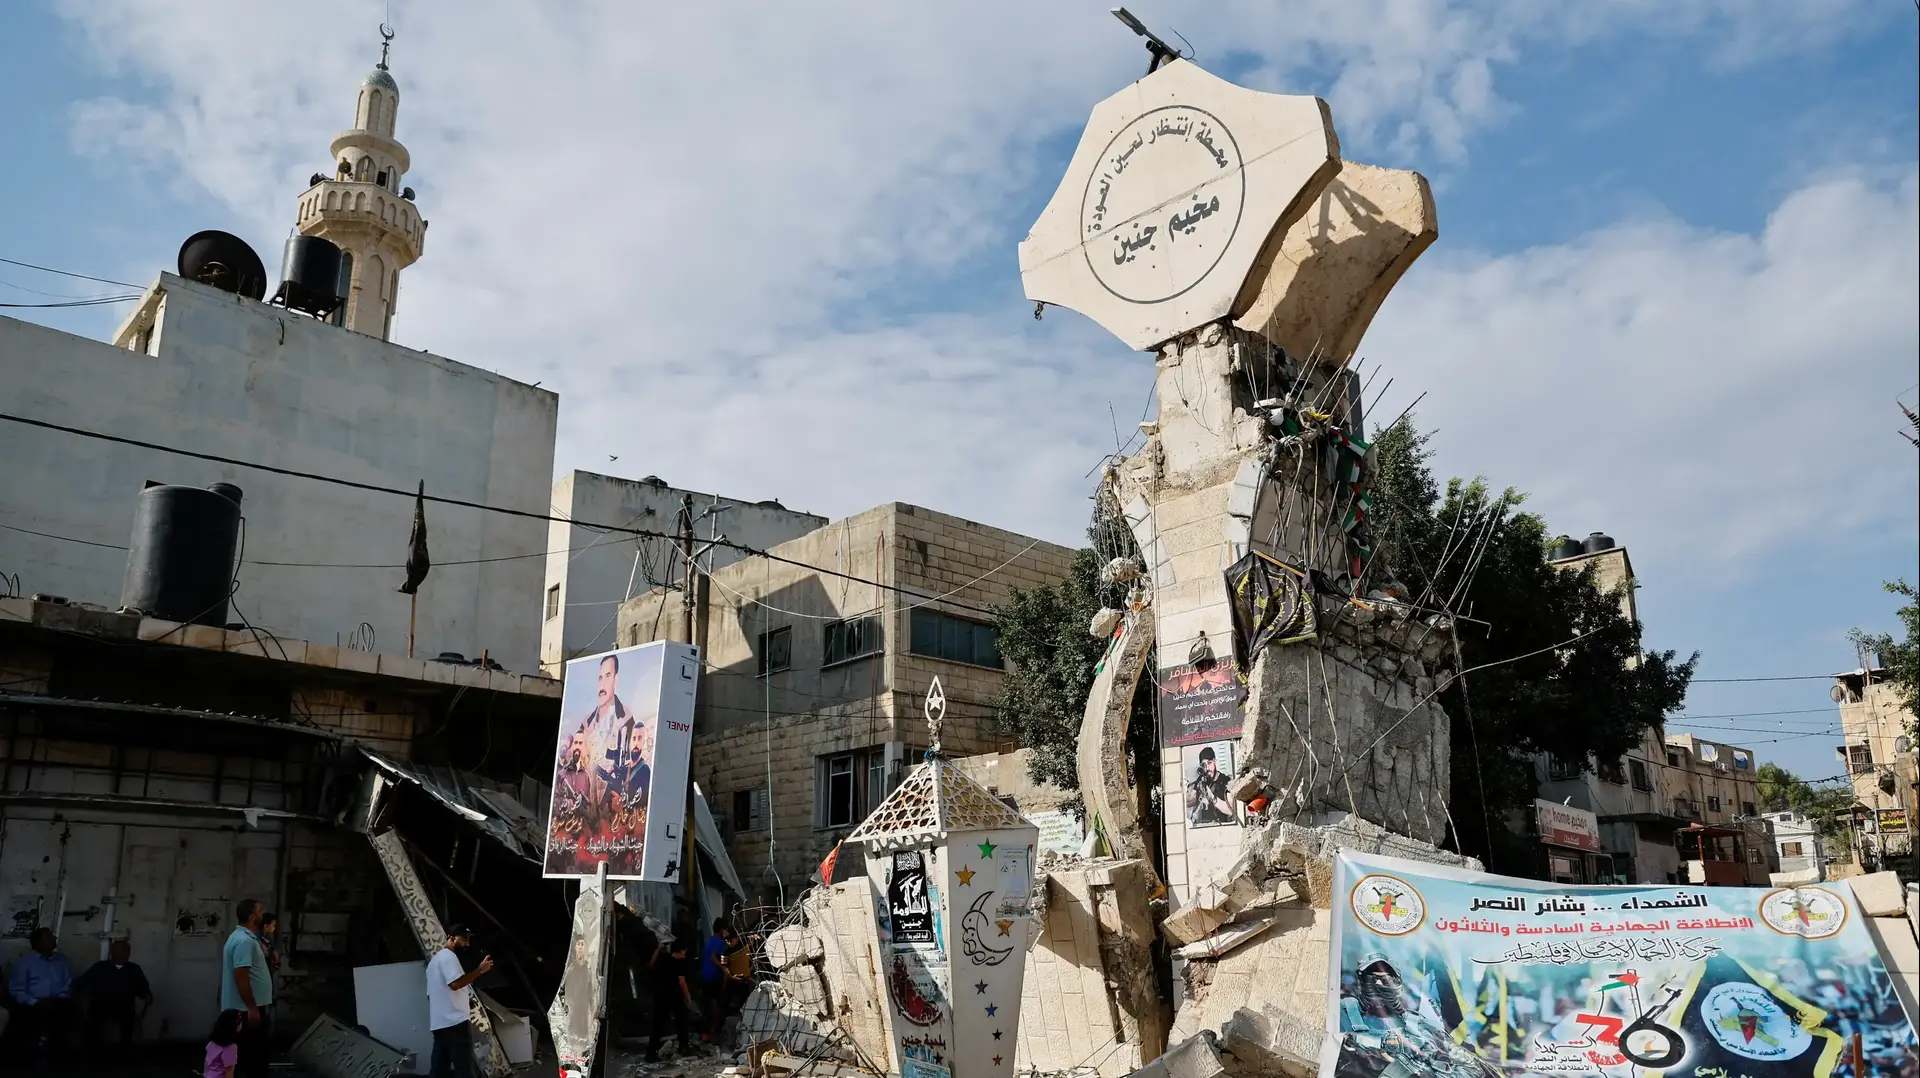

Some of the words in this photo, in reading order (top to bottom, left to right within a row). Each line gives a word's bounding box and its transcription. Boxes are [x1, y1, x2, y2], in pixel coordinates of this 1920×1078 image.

[1148, 116, 1194, 144] إنتظار
[1110, 132, 1143, 174] لحين
[1195, 121, 1228, 169] محطة
[1088, 173, 1113, 233] العودة
[1168, 194, 1220, 243] مخيم
[1113, 223, 1158, 266] جنين
[1470, 896, 1526, 912] النصر
[1535, 895, 1585, 915] بشائر
[1621, 892, 1708, 910] الشهداء
[1435, 917, 1510, 936] والثلاثون
[1516, 922, 1584, 935] السادسة
[1590, 920, 1670, 936] الجهادية
[1677, 917, 1754, 932] الإنطلاقة
[1678, 937, 1722, 962] حركة
[901, 1035, 922, 1049] جنين
[924, 1033, 946, 1051] بلدية
